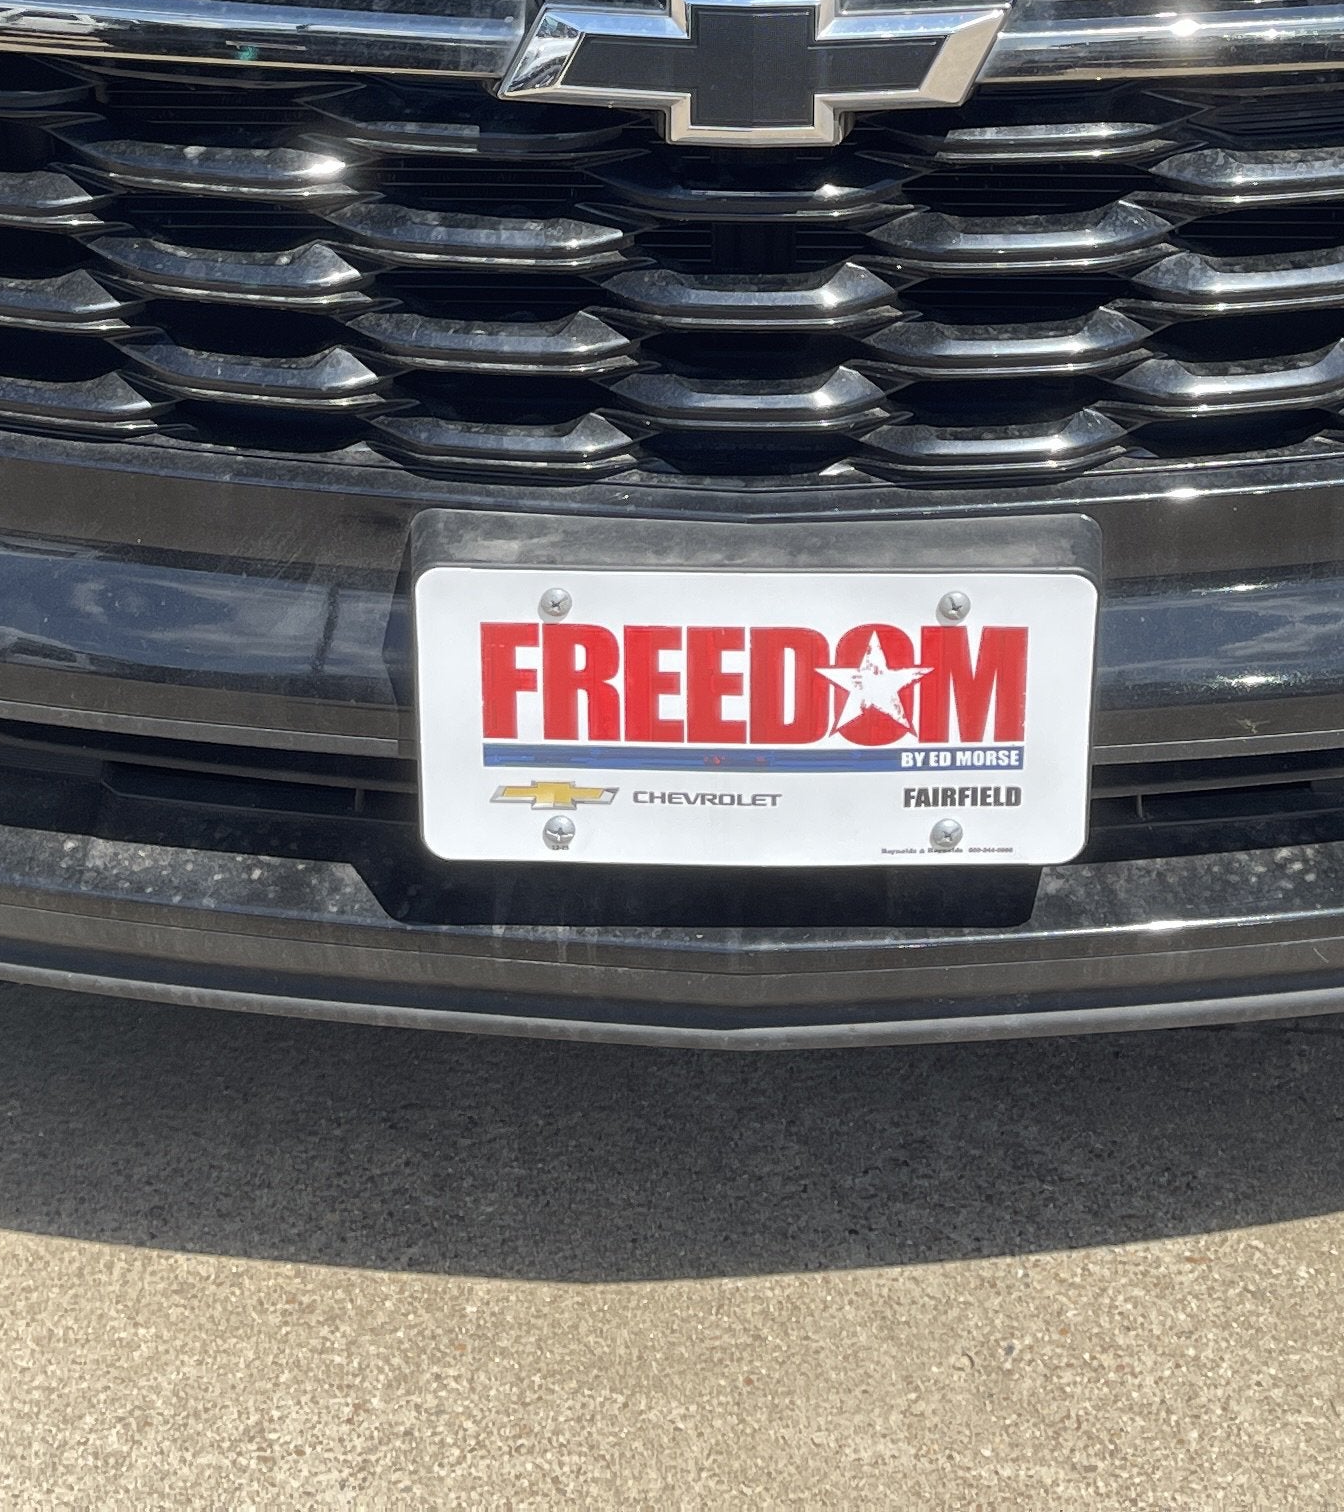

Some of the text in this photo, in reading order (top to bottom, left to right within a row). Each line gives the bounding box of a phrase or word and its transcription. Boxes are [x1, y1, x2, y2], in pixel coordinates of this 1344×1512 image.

[480, 622, 1030, 747] FREEDOM
[901, 750, 1020, 768] BY ED MORSE
[632, 790, 783, 807] CHEVROLET
[903, 786, 1023, 808] FAIRFIELD
